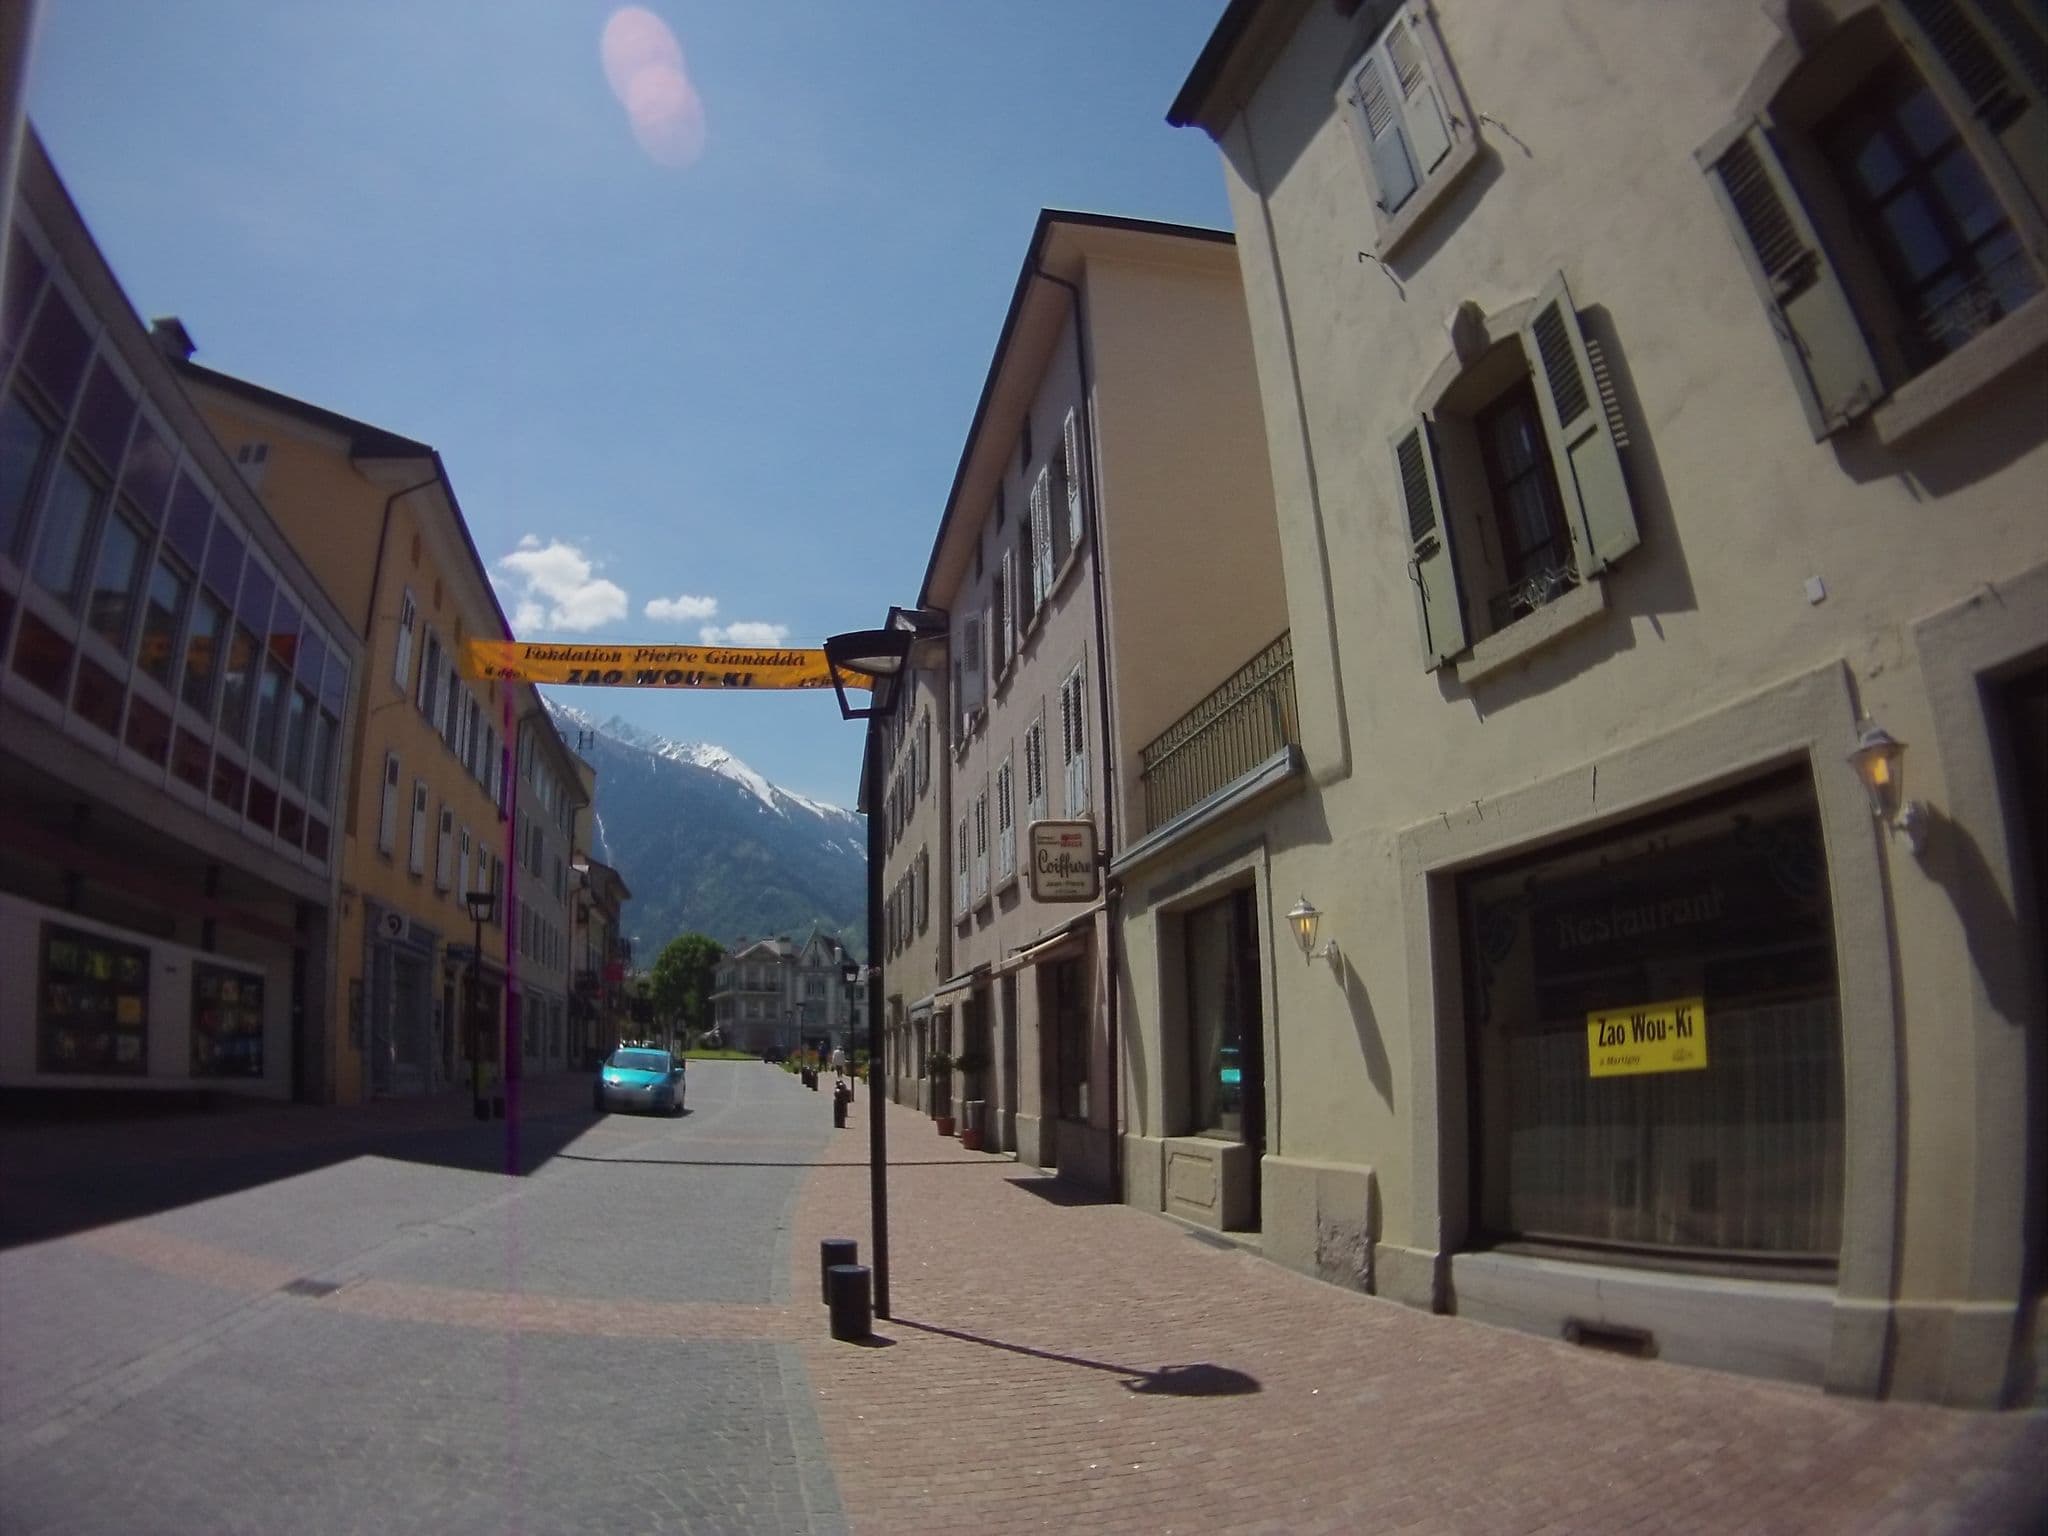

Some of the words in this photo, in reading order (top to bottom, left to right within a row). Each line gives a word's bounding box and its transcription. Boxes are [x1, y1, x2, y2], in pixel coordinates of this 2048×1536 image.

[525, 645, 622, 663] Fondation
[634, 648, 698, 663] Pierre
[705, 650, 806, 667] Gianadda
[566, 668, 623, 685] ZAO
[635, 669, 753, 687] WOU-KI
[1039, 848, 1091, 878] Coiffure
[1556, 882, 1728, 949] Restaurant
[1598, 1016, 1626, 1047] Zao
[1630, 1007, 1694, 1044] Wou-Ki
